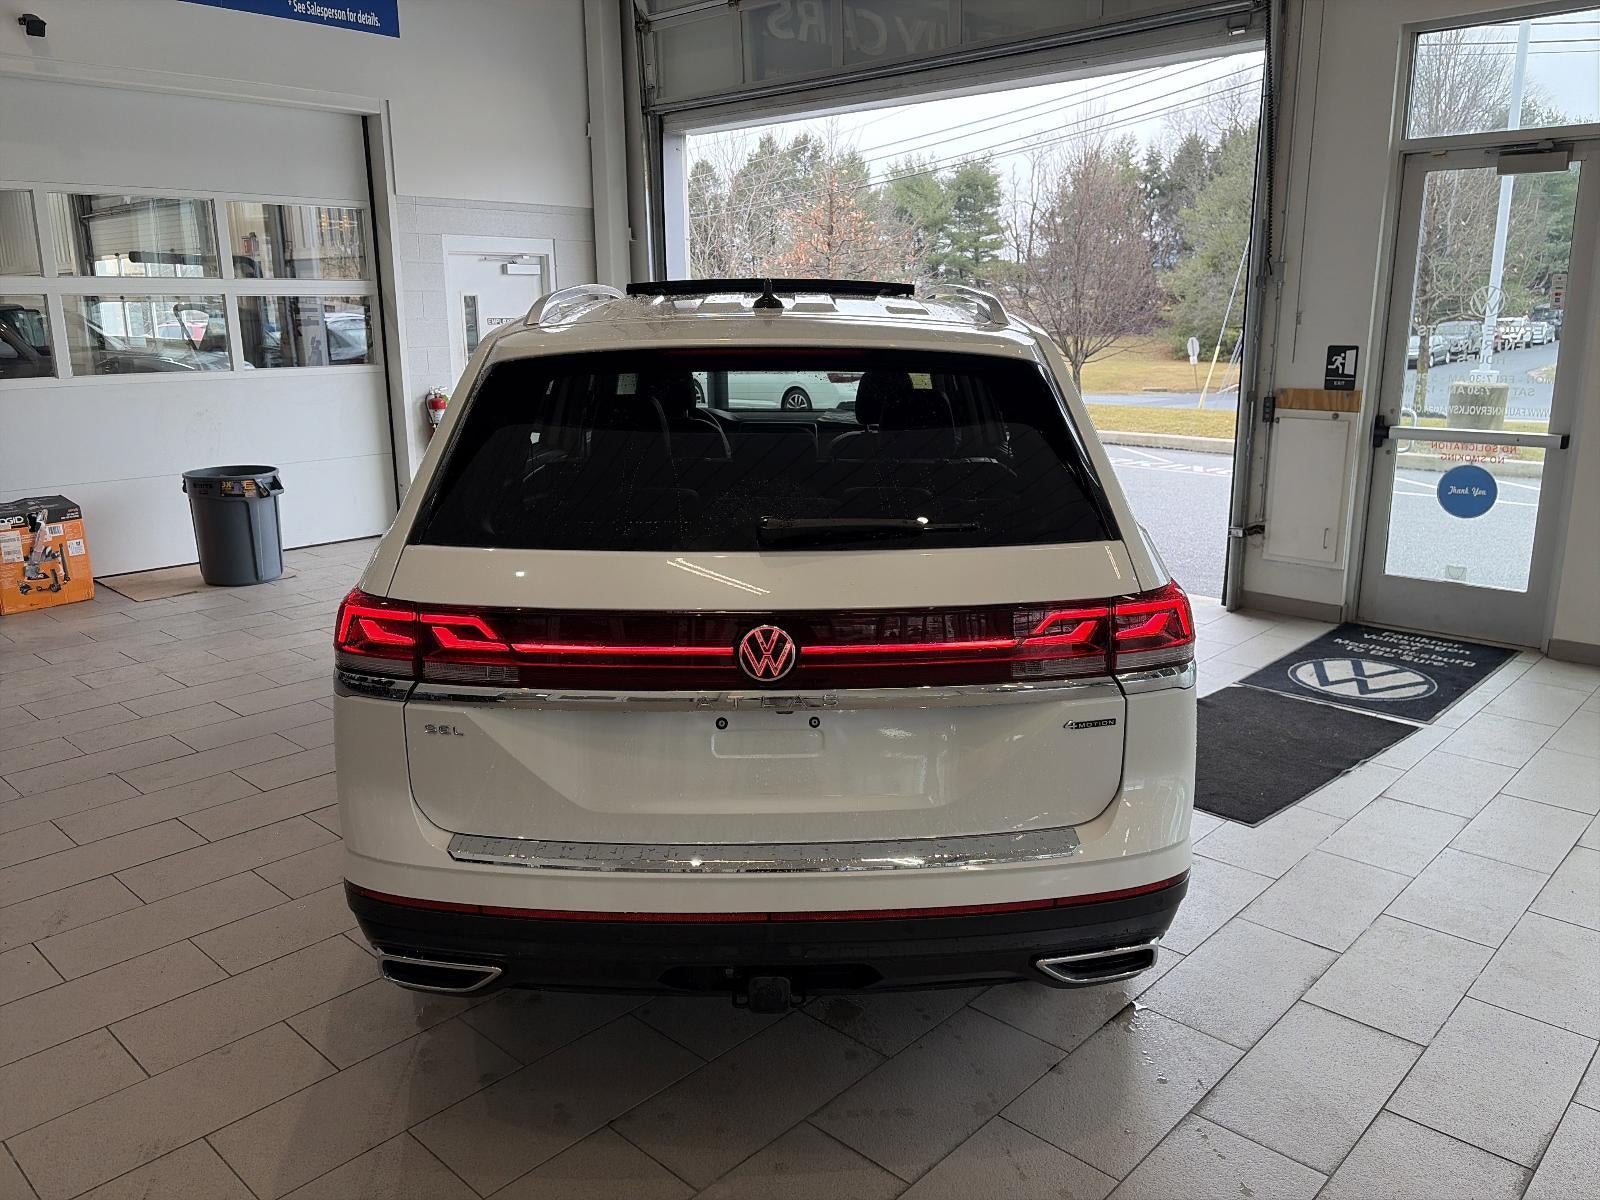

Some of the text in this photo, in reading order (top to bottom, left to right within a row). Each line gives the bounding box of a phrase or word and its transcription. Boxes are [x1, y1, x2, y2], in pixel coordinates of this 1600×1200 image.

[293, 0, 381, 27] See Salesperson for details.
[1447, 485, 1487, 497] Thank You
[1363, 633, 1471, 655] Volkswagen
[1382, 631, 1463, 648] Faulkner
[1333, 638, 1477, 668] Mechanicsburg
[1346, 644, 1365, 653] To
[424, 723, 464, 737] SEL
[1063, 719, 1117, 730] 4MOTION
